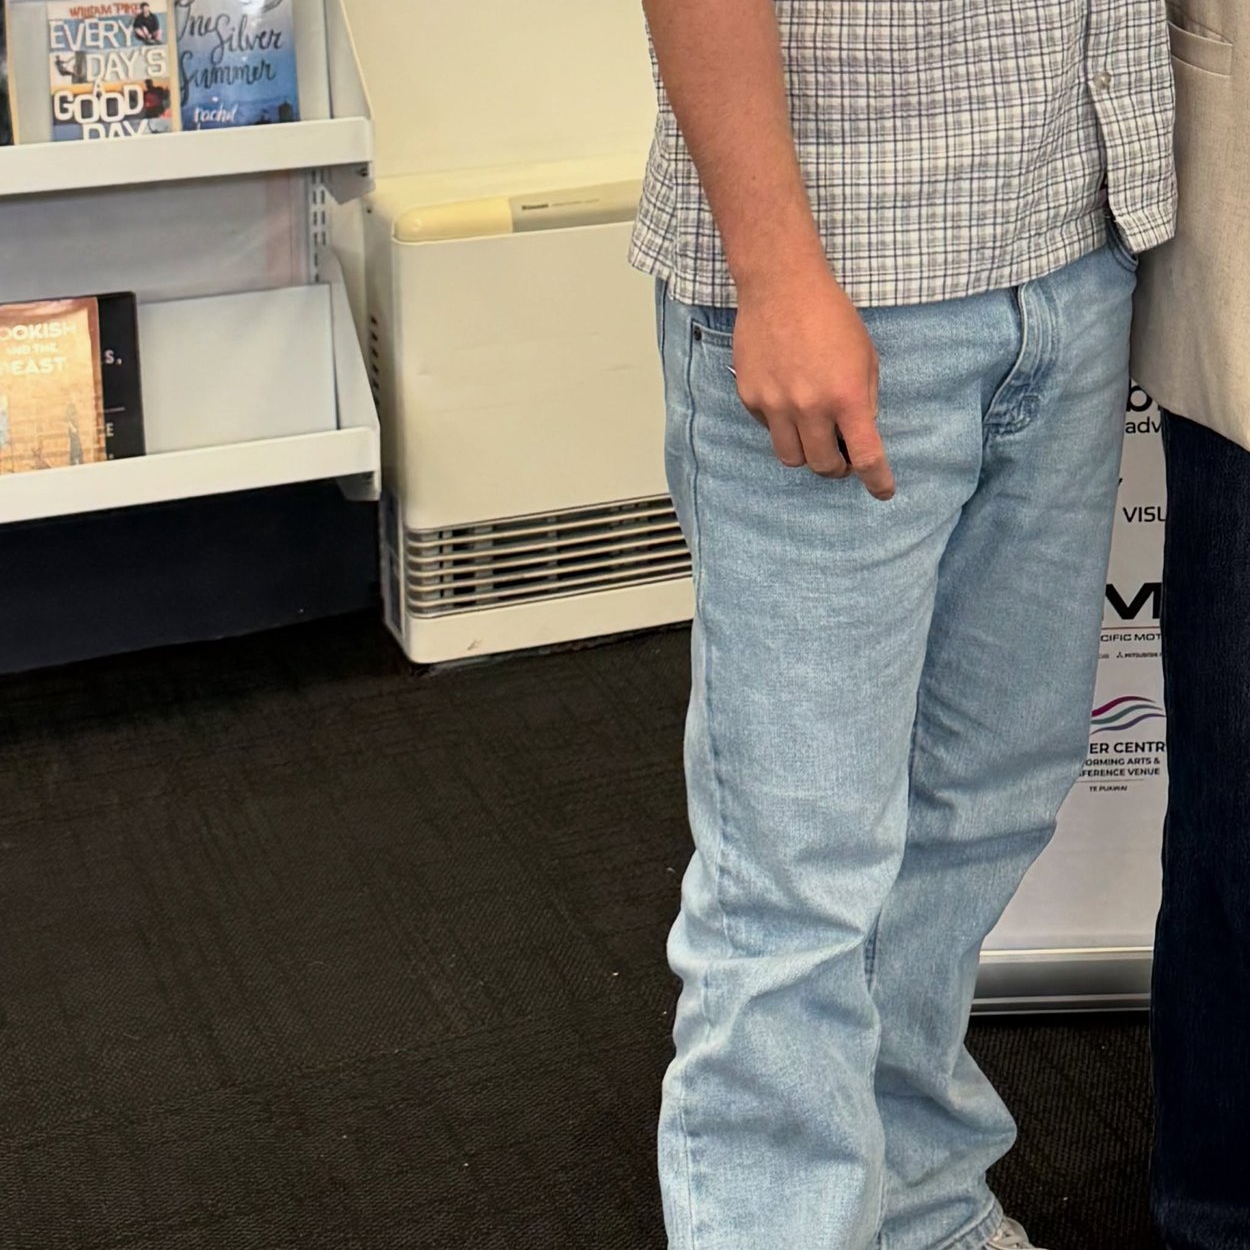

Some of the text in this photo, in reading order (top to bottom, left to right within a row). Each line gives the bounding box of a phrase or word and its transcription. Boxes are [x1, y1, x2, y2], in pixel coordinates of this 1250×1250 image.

[50, 19, 135, 50] EVERY
[210, 12, 283, 68] Silver
[86, 46, 168, 82] DAY'S
[178, 50, 277, 102] Summer
[93, 80, 103, 97] A
[54, 84, 144, 124] GOOD
[83, 118, 148, 141] DAY
[0, 356, 66, 376] EAST
[1100, 634, 1132, 642] CIFIC
[1089, 742, 1110, 754] ER
[1127, 757, 1152, 765] ARTS
[1079, 768, 1160, 777] FERENCE VENUE
